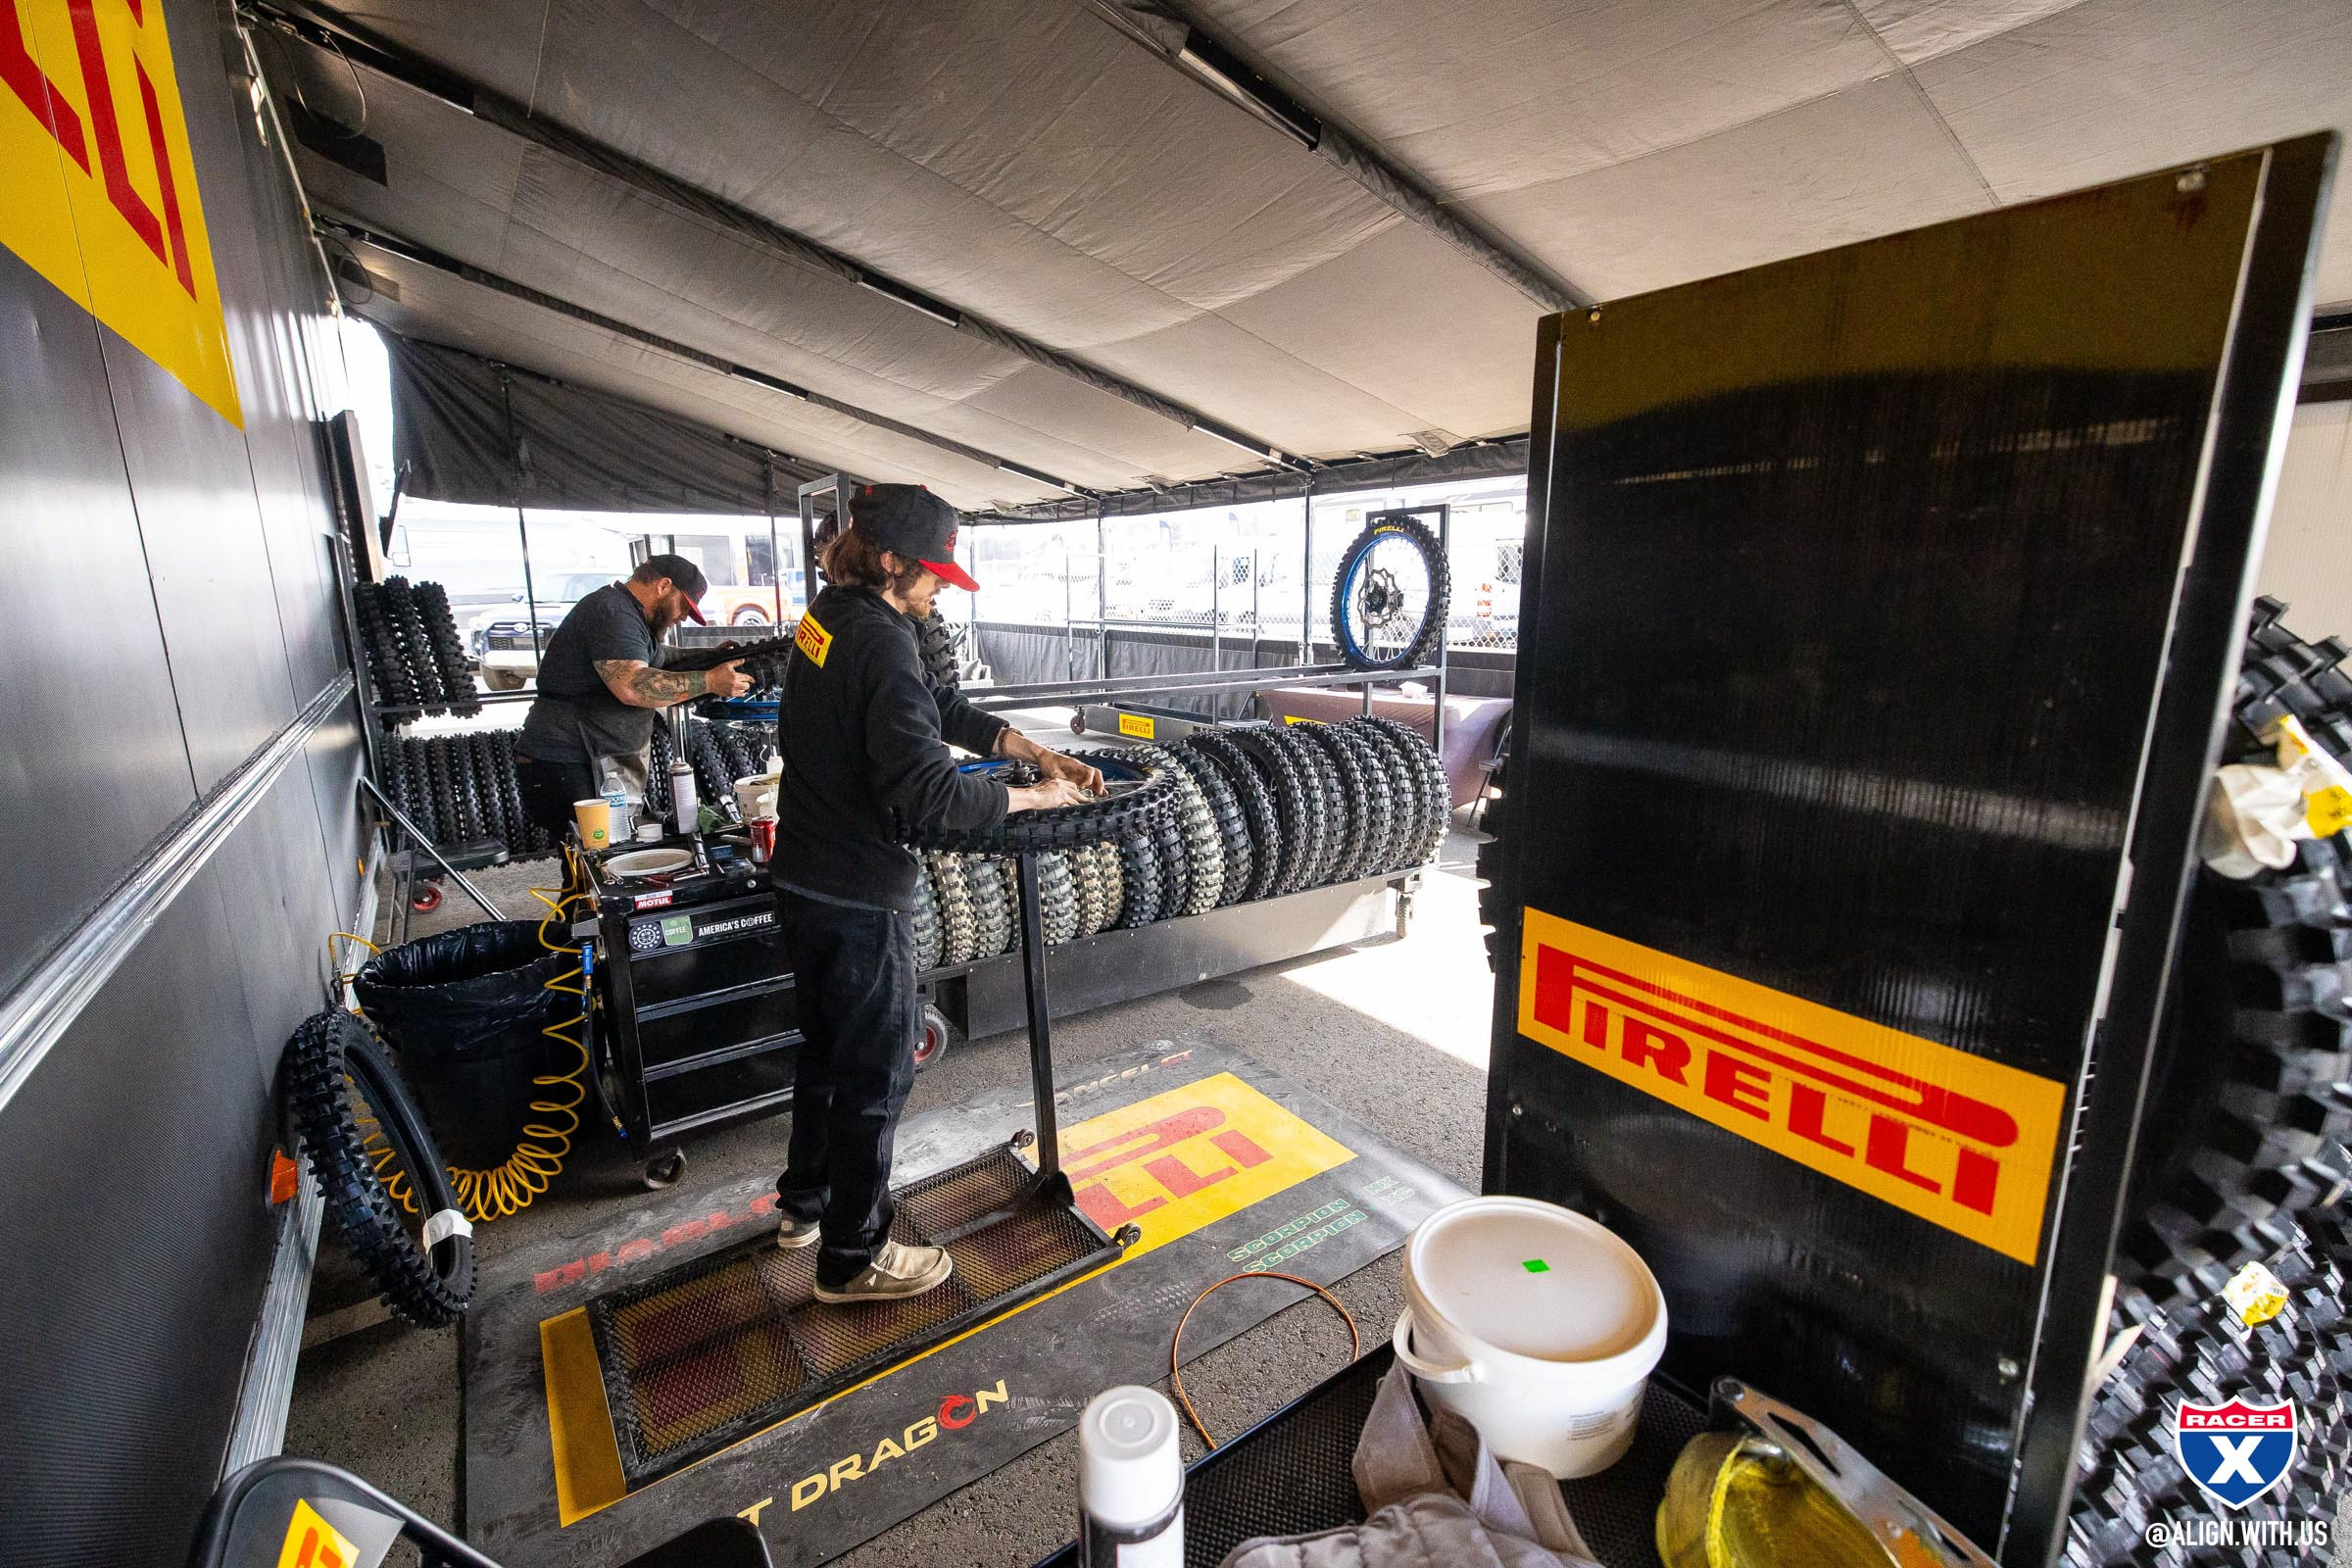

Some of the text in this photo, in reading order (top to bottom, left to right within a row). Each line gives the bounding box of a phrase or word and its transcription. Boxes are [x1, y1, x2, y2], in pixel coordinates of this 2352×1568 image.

[1374, 525, 1404, 535] PIRELLI
[1122, 718, 1151, 734] PIRELLI
[638, 897, 670, 908] MOTUL
[665, 925, 687, 936] COFFEE
[699, 920, 740, 937] AMERICA'S
[1534, 943, 2019, 1216] PIRELLI
[1227, 1199, 1350, 1261] SCORPION
[1243, 1209, 1368, 1273] SCORPION
[791, 1379, 1008, 1512] DRAGON
